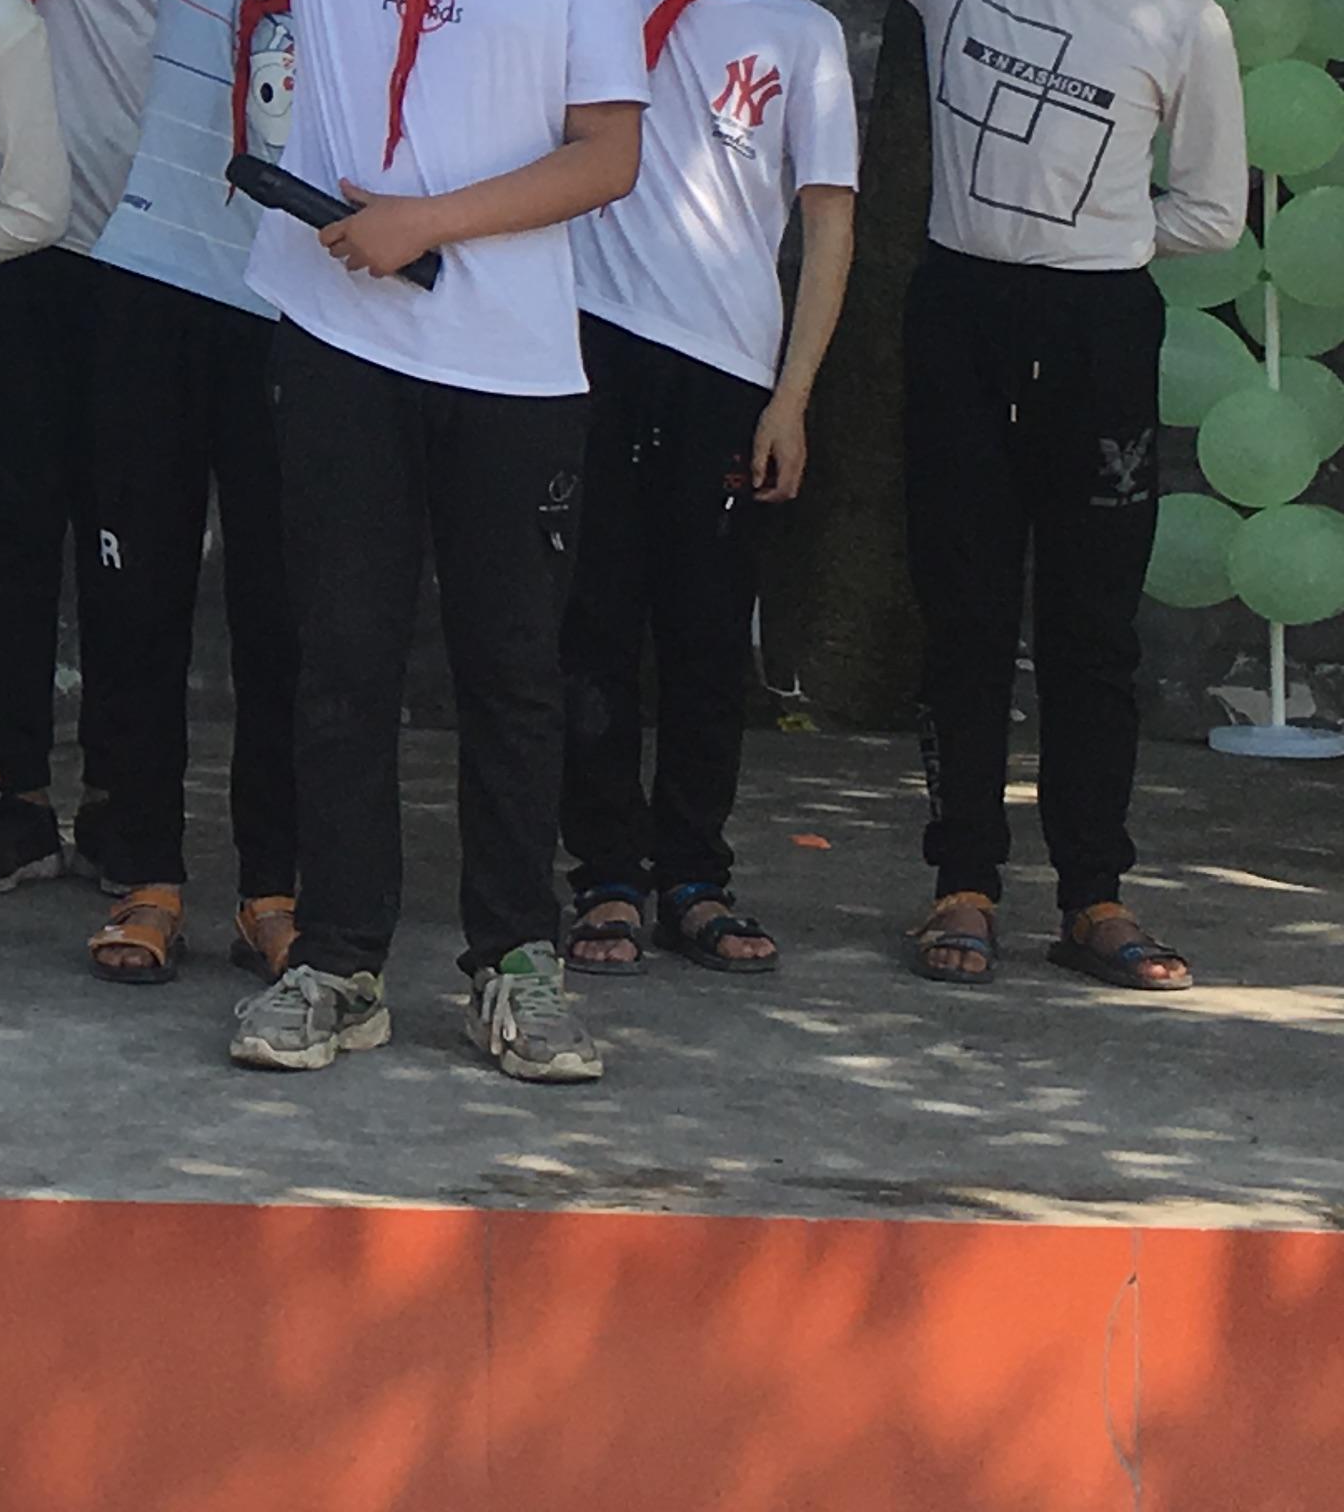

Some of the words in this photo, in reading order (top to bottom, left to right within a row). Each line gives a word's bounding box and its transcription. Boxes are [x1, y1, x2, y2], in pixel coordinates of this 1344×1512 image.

[711, 54, 783, 127] NY
[1011, 61, 1098, 102] FASHION
[99, 528, 122, 570] R
